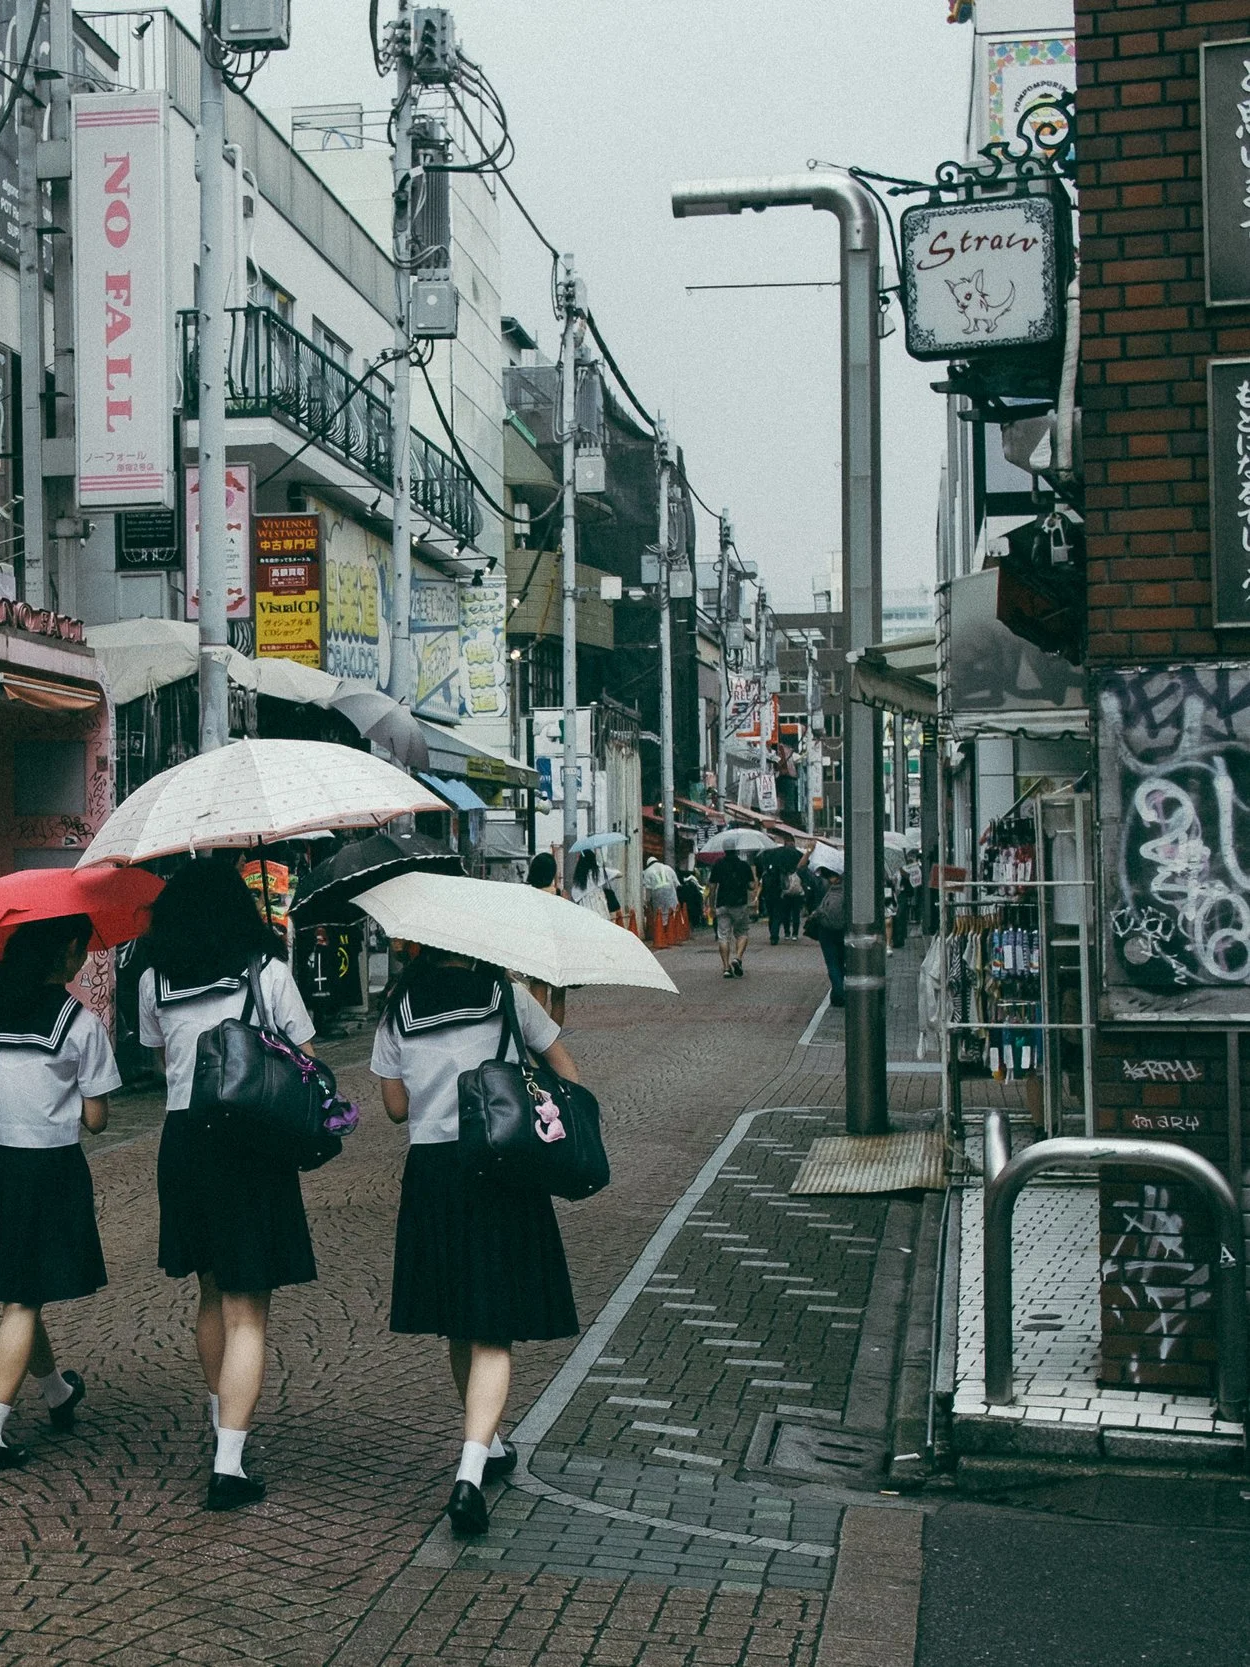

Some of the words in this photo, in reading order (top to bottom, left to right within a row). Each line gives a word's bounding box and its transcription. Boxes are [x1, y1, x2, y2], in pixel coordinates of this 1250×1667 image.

[1013, 81, 1068, 113] POMPOMPURIN
[104, 152, 130, 248] NO
[917, 229, 1039, 270] Straw
[105, 270, 132, 433] FALL
[85, 451, 147, 464] ノーフォール
[261, 519, 313, 529] VIVIENNE
[257, 528, 319, 538] WESTWOOD
[260, 539, 317, 551] 中古専門店
[259, 601, 297, 614] Visual
[297, 601, 320, 614] CD
